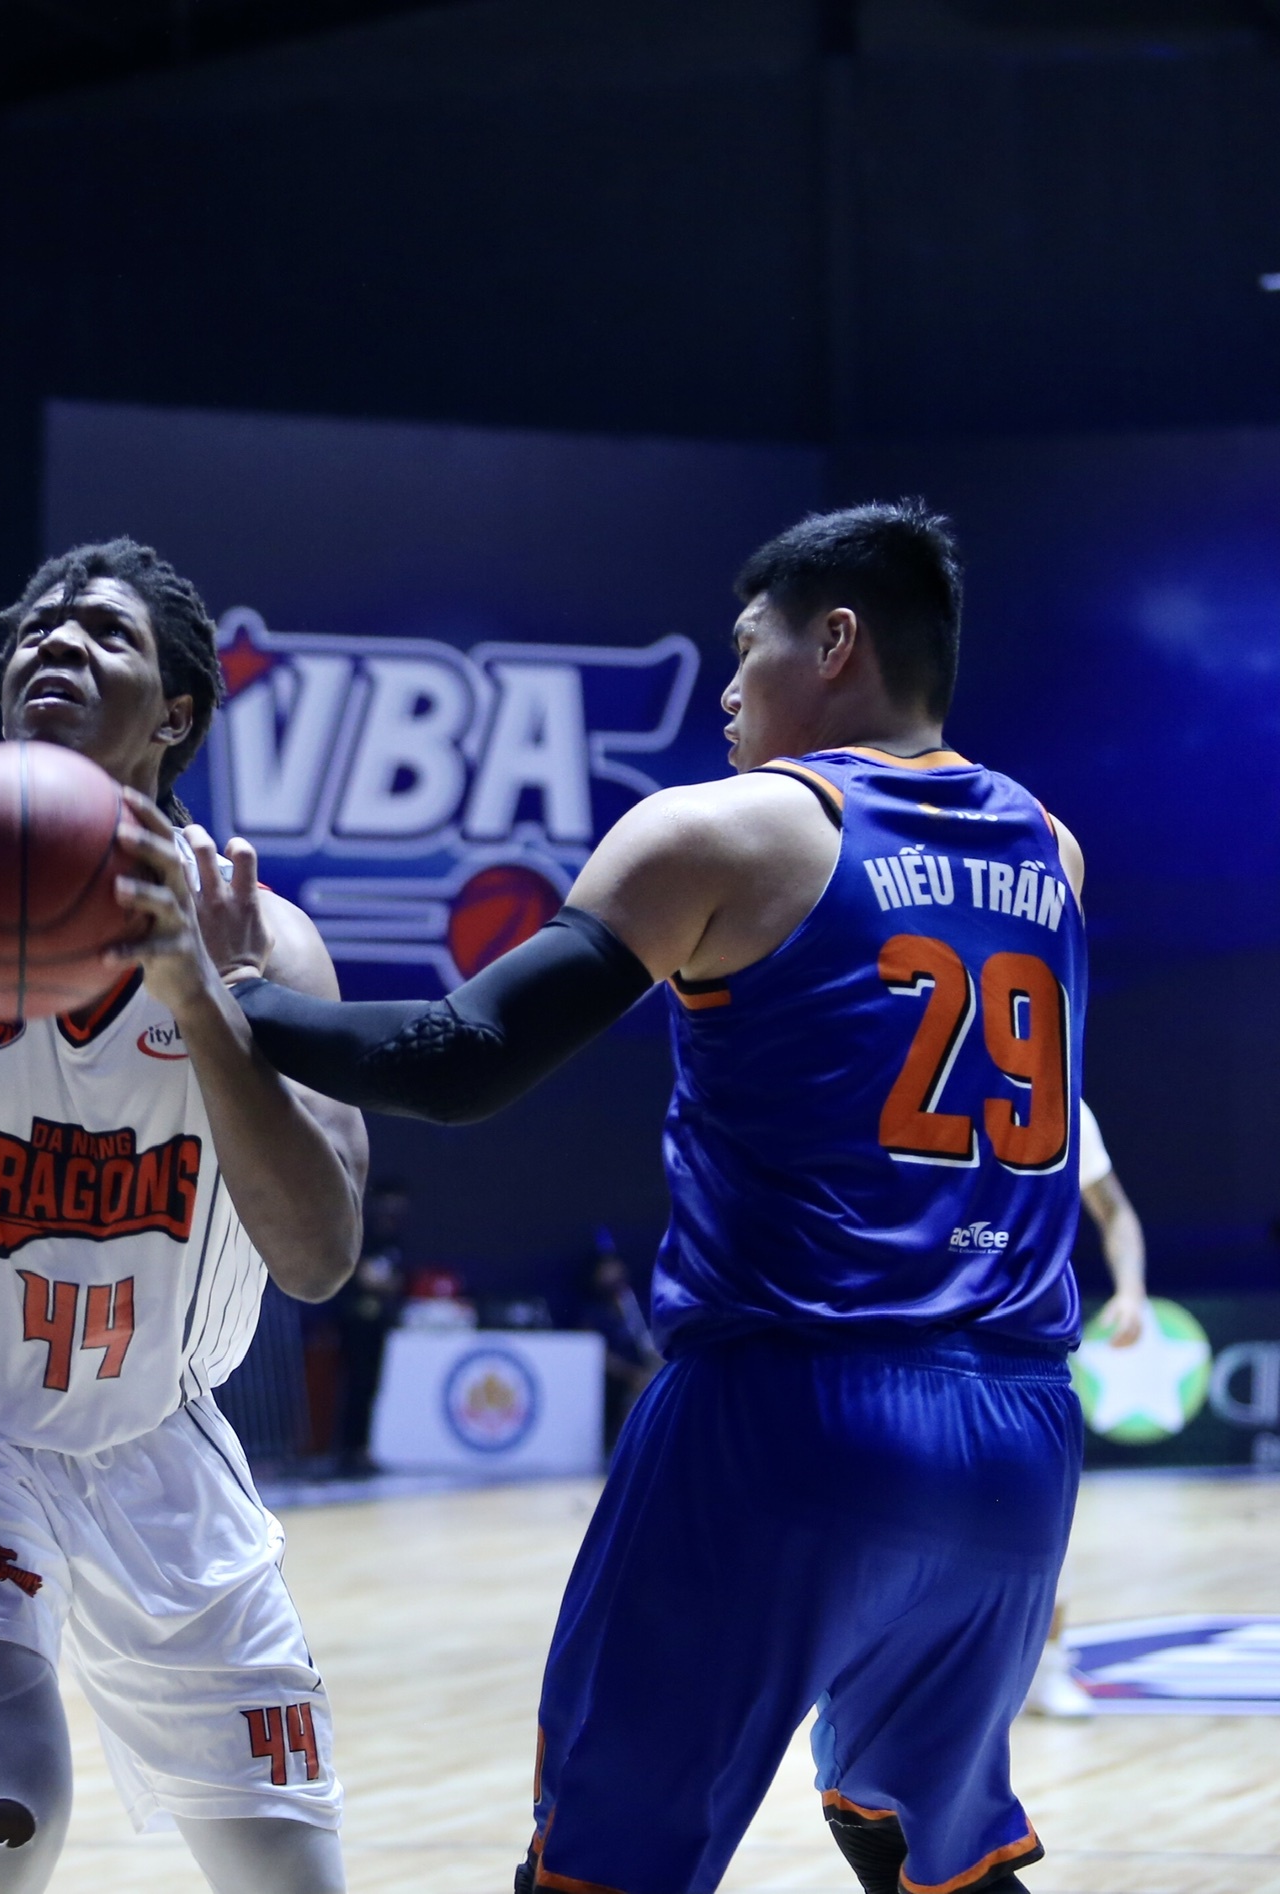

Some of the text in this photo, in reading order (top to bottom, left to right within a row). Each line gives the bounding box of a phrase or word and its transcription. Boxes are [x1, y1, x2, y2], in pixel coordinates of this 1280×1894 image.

[226, 652, 595, 842] VBA
[863, 844, 1066, 933] HIẾU TRẦN
[877, 933, 1073, 1176] 29
[32, 1122, 132, 1161] DA NANG
[16, 1269, 135, 1392] 44
[239, 1702, 320, 1787] 44
